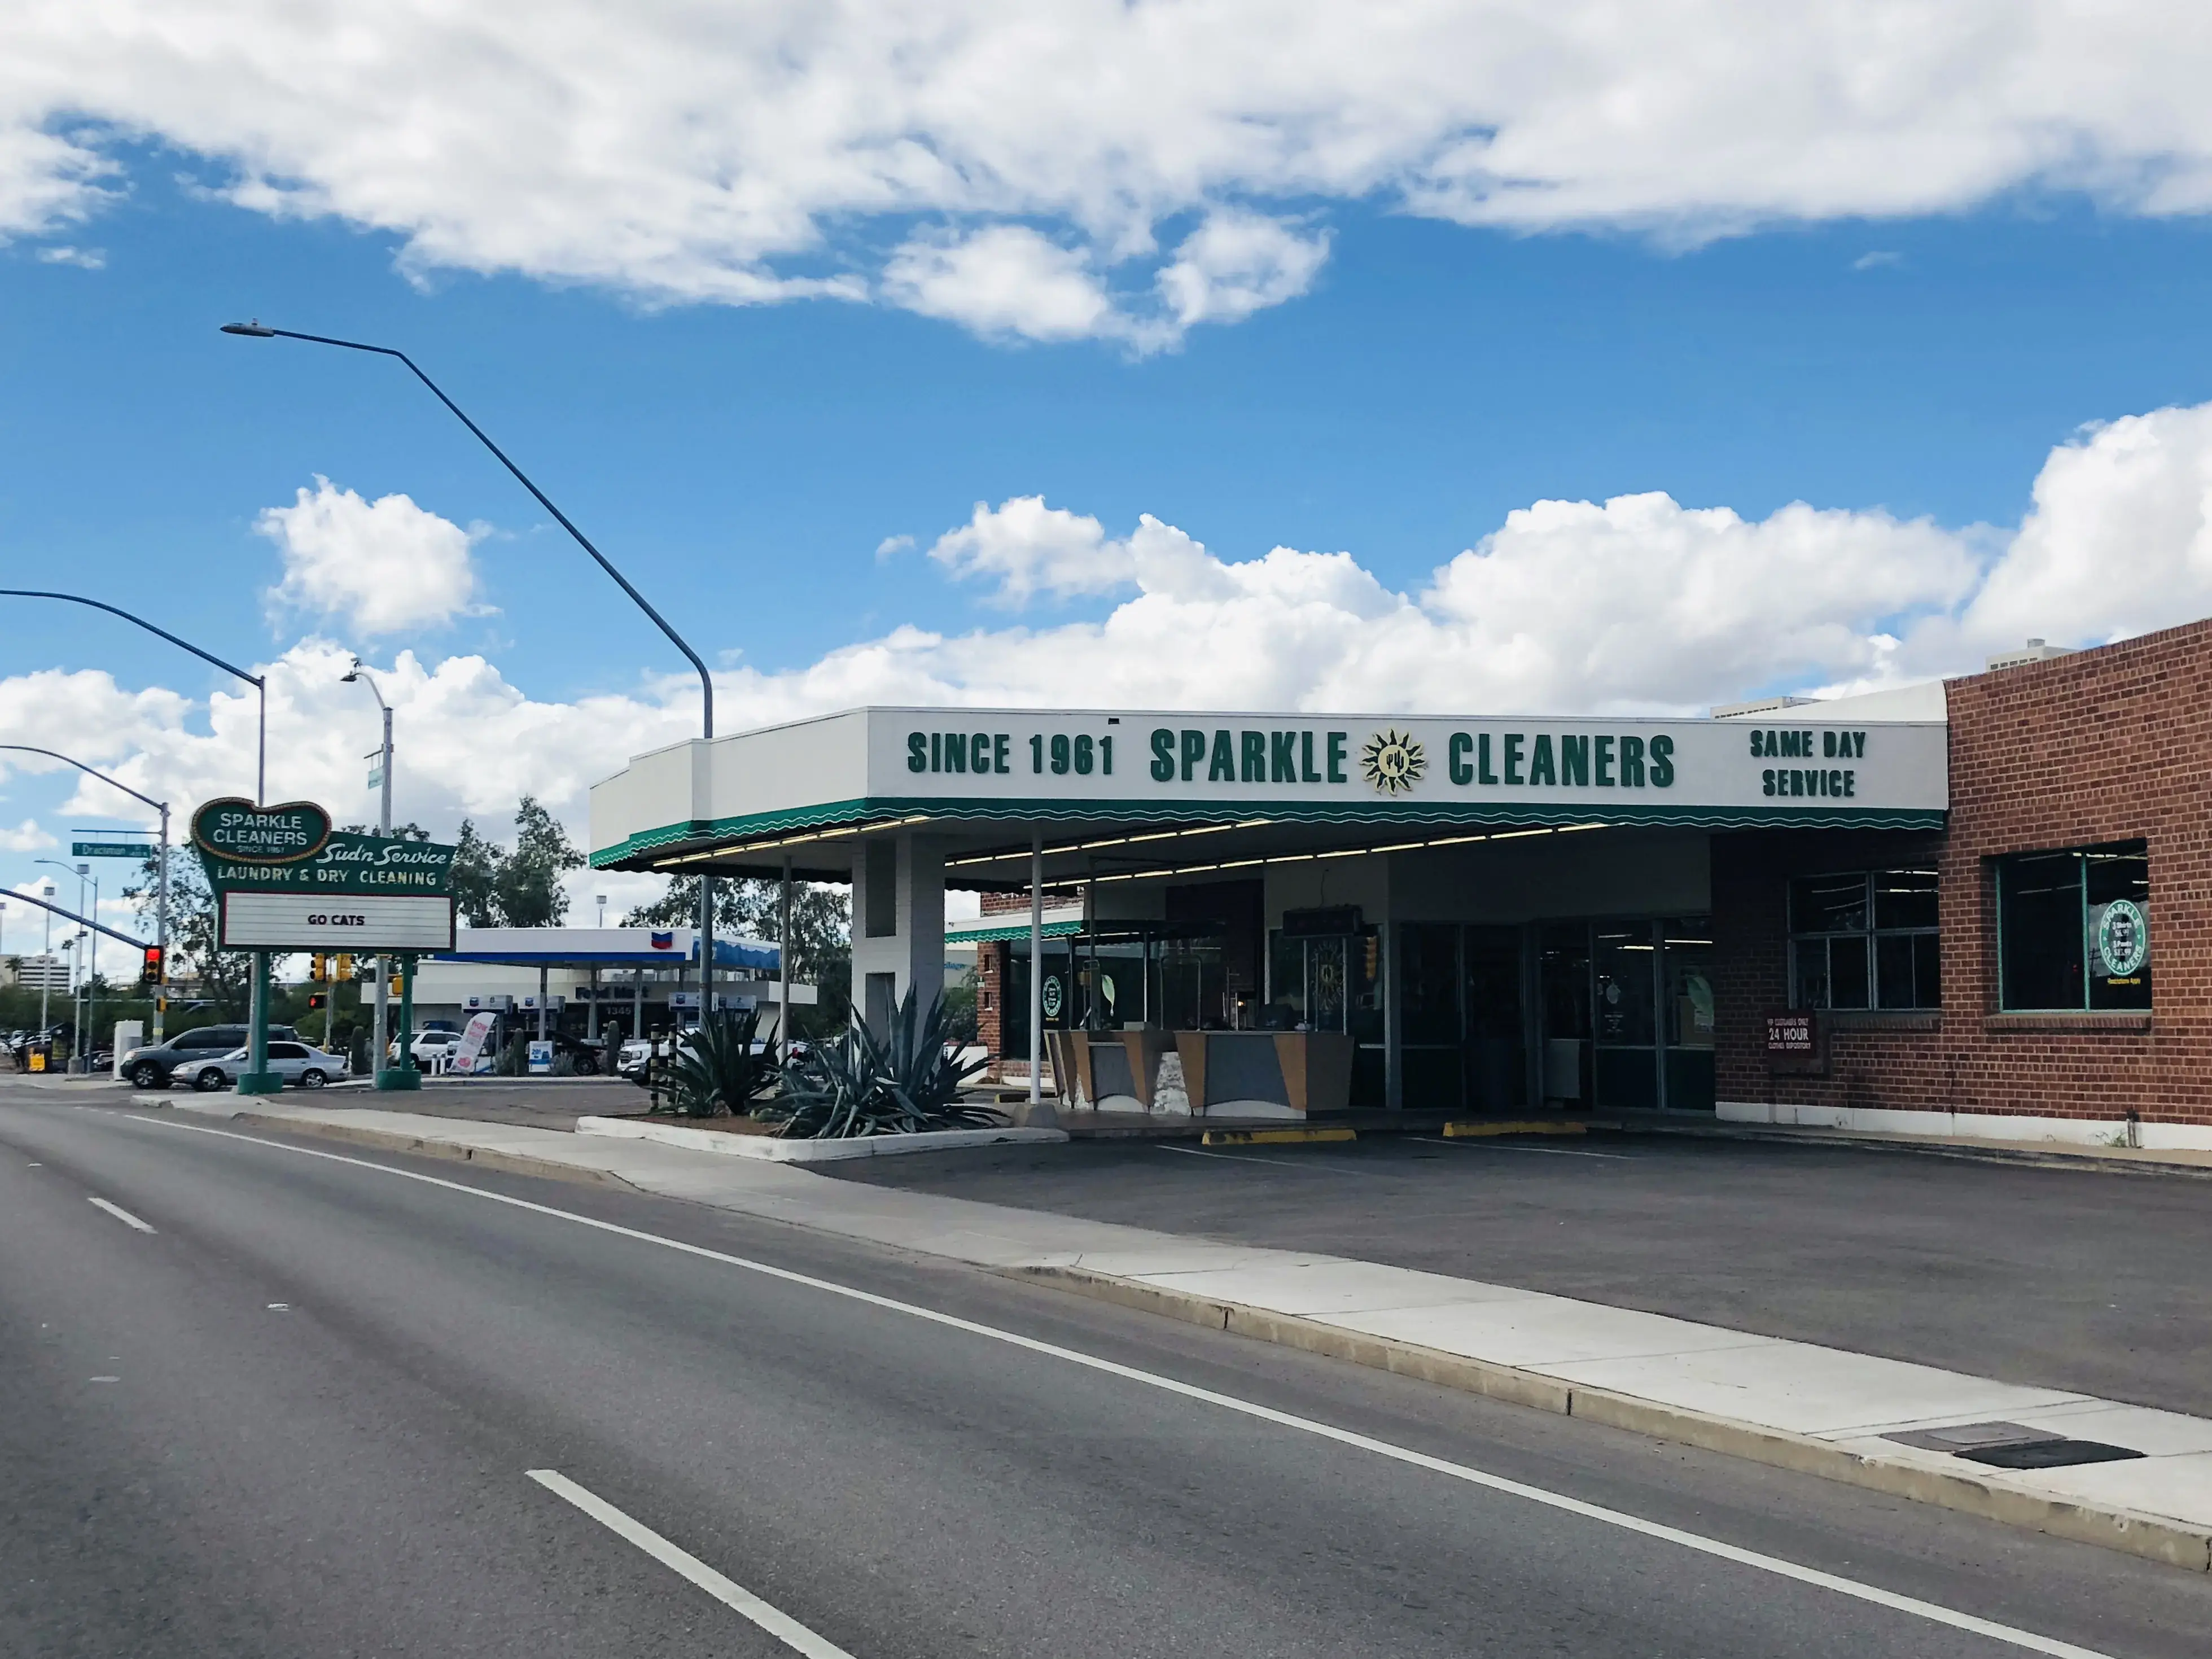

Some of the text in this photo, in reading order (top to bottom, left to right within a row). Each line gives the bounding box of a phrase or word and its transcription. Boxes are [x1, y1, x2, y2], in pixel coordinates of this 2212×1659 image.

[908, 732, 1113, 776] SINCE 1961
[1750, 730, 1865, 758] SAME DAY
[1150, 729, 1674, 788] SPARKLE CLEANERS
[1763, 769, 1854, 797] SERVICE
[220, 812, 302, 830] SPARKLE
[213, 829, 307, 846] CLEANERS
[374, 844, 447, 866] Service
[217, 865, 437, 886] LAUNDRY & DRY CLEANING
[308, 914, 365, 926] GO CATS
[2103, 903, 2141, 930] SPARKLE
[2103, 944, 2143, 971] CLEANERS
[606, 1006, 632, 1015] 1345
[1768, 1027, 1809, 1040] 24 HOUR
